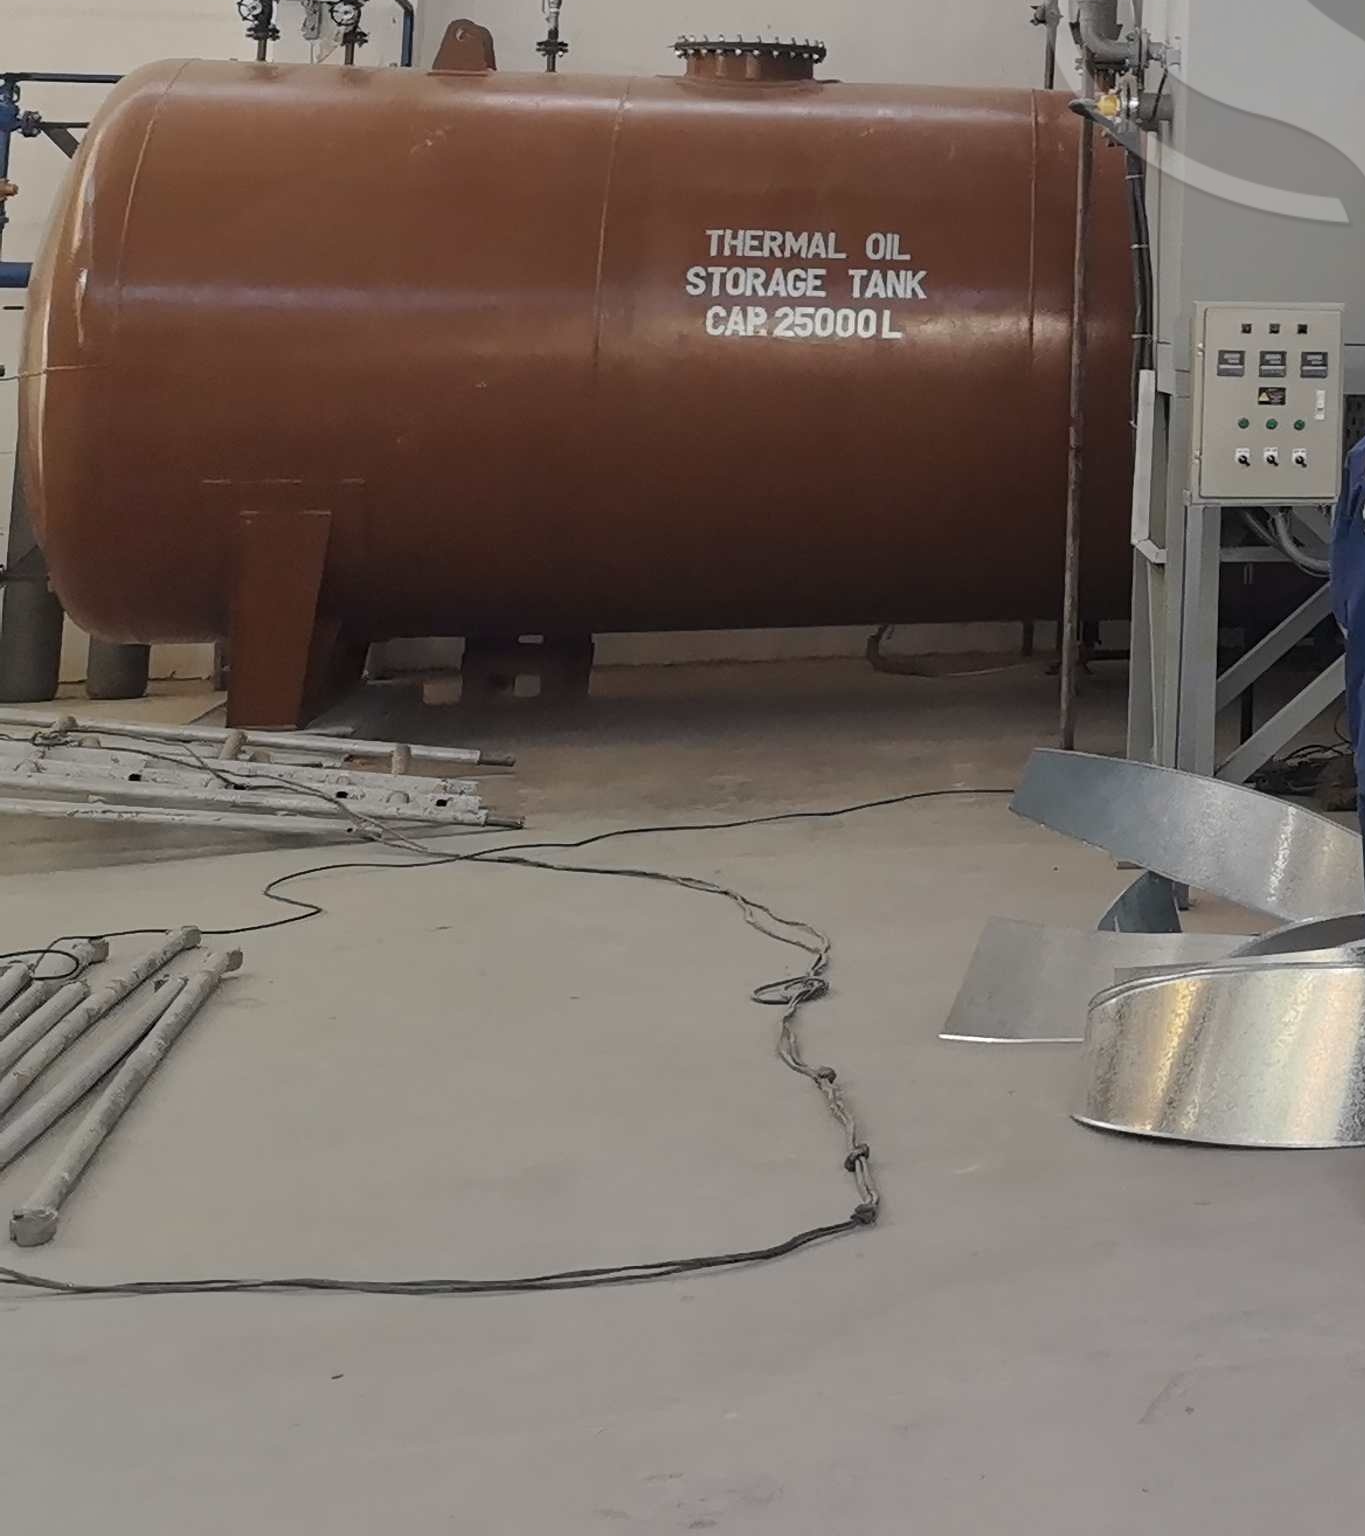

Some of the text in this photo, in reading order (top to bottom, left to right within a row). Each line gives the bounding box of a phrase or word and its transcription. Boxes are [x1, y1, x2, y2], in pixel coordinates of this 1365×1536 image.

[705, 228, 911, 260] THERMAL OIL
[685, 266, 928, 299] STORAGE TANK
[772, 306, 877, 339] 25000
[881, 309, 903, 339] L
